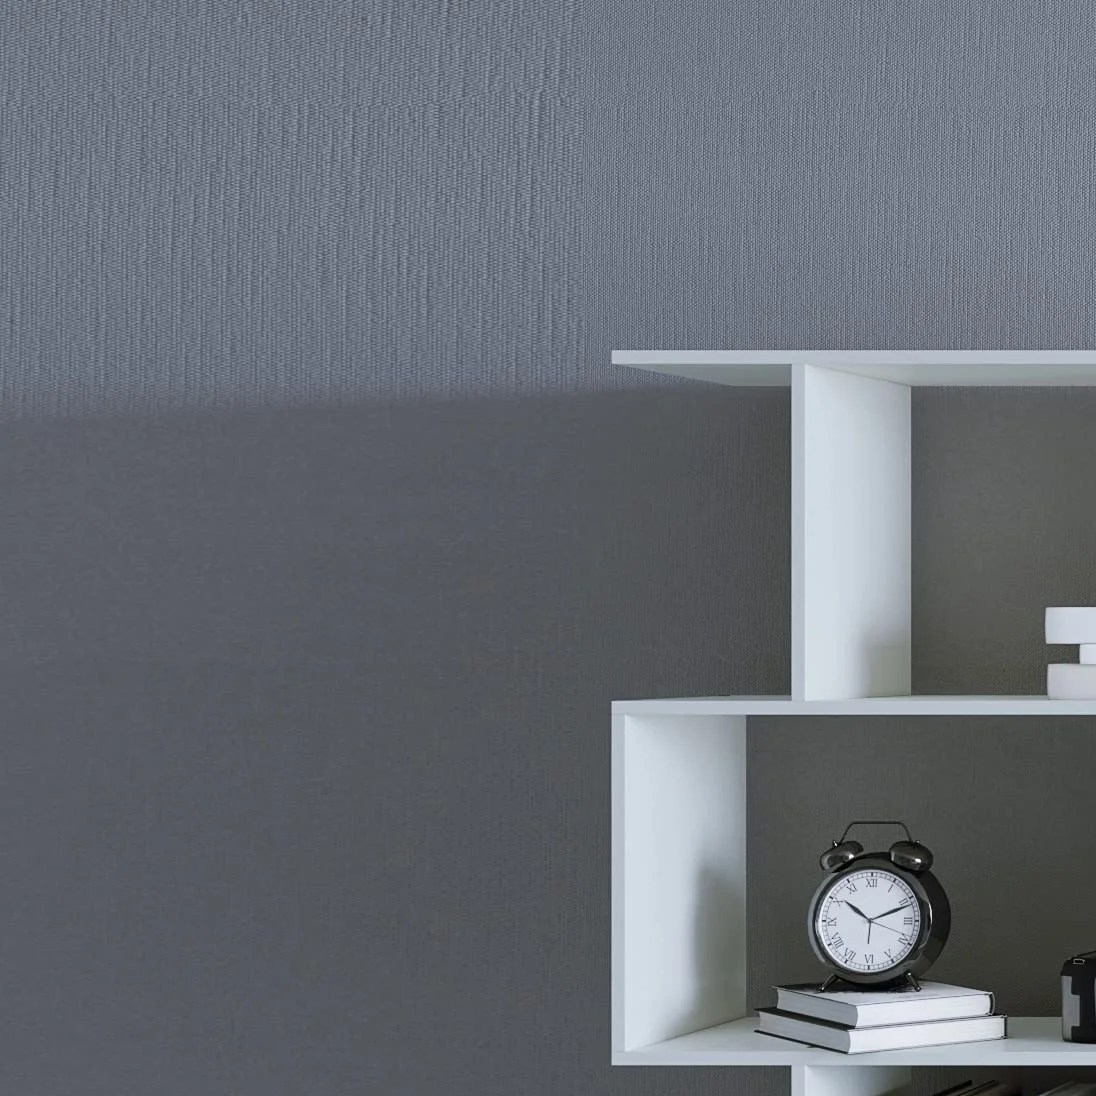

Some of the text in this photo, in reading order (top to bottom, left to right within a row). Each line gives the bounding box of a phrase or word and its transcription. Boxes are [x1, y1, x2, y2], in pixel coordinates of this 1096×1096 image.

[865, 878, 878, 888] XII
[846, 883, 858, 894] XI
[904, 917, 913, 925] III
[844, 947, 857, 960] VII
[884, 948, 893, 959] V
[864, 954, 874, 964] VI
